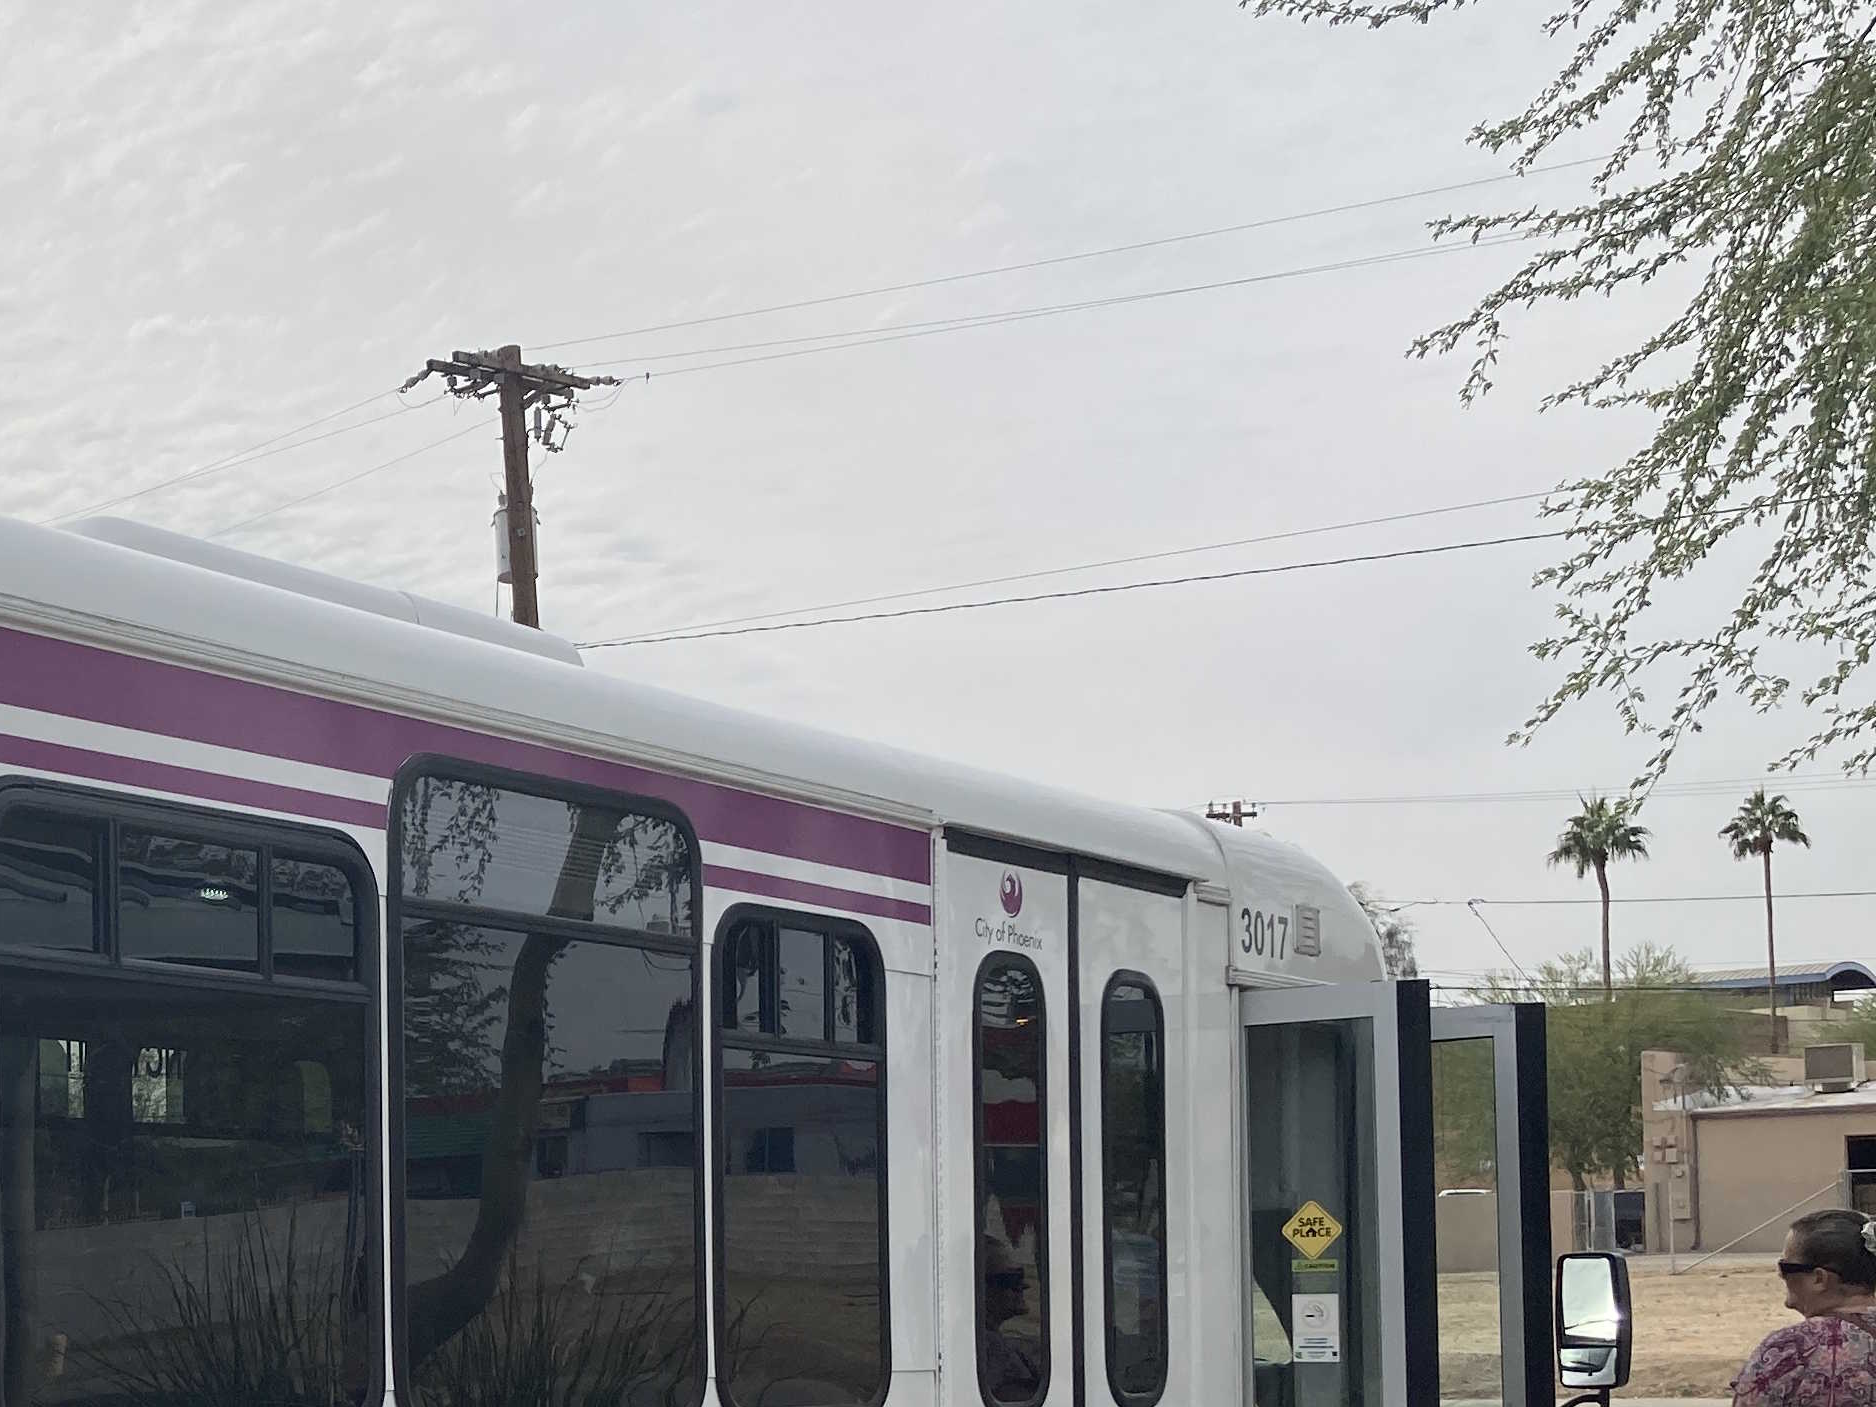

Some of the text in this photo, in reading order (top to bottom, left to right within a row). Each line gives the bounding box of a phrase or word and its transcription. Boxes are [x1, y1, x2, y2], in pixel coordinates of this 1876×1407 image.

[975, 917, 1043, 950] City of Phoenix
[1241, 908, 1288, 960] 3017
[1292, 1227, 1332, 1238] PLACE
[1298, 1216, 1325, 1227] SAFE
